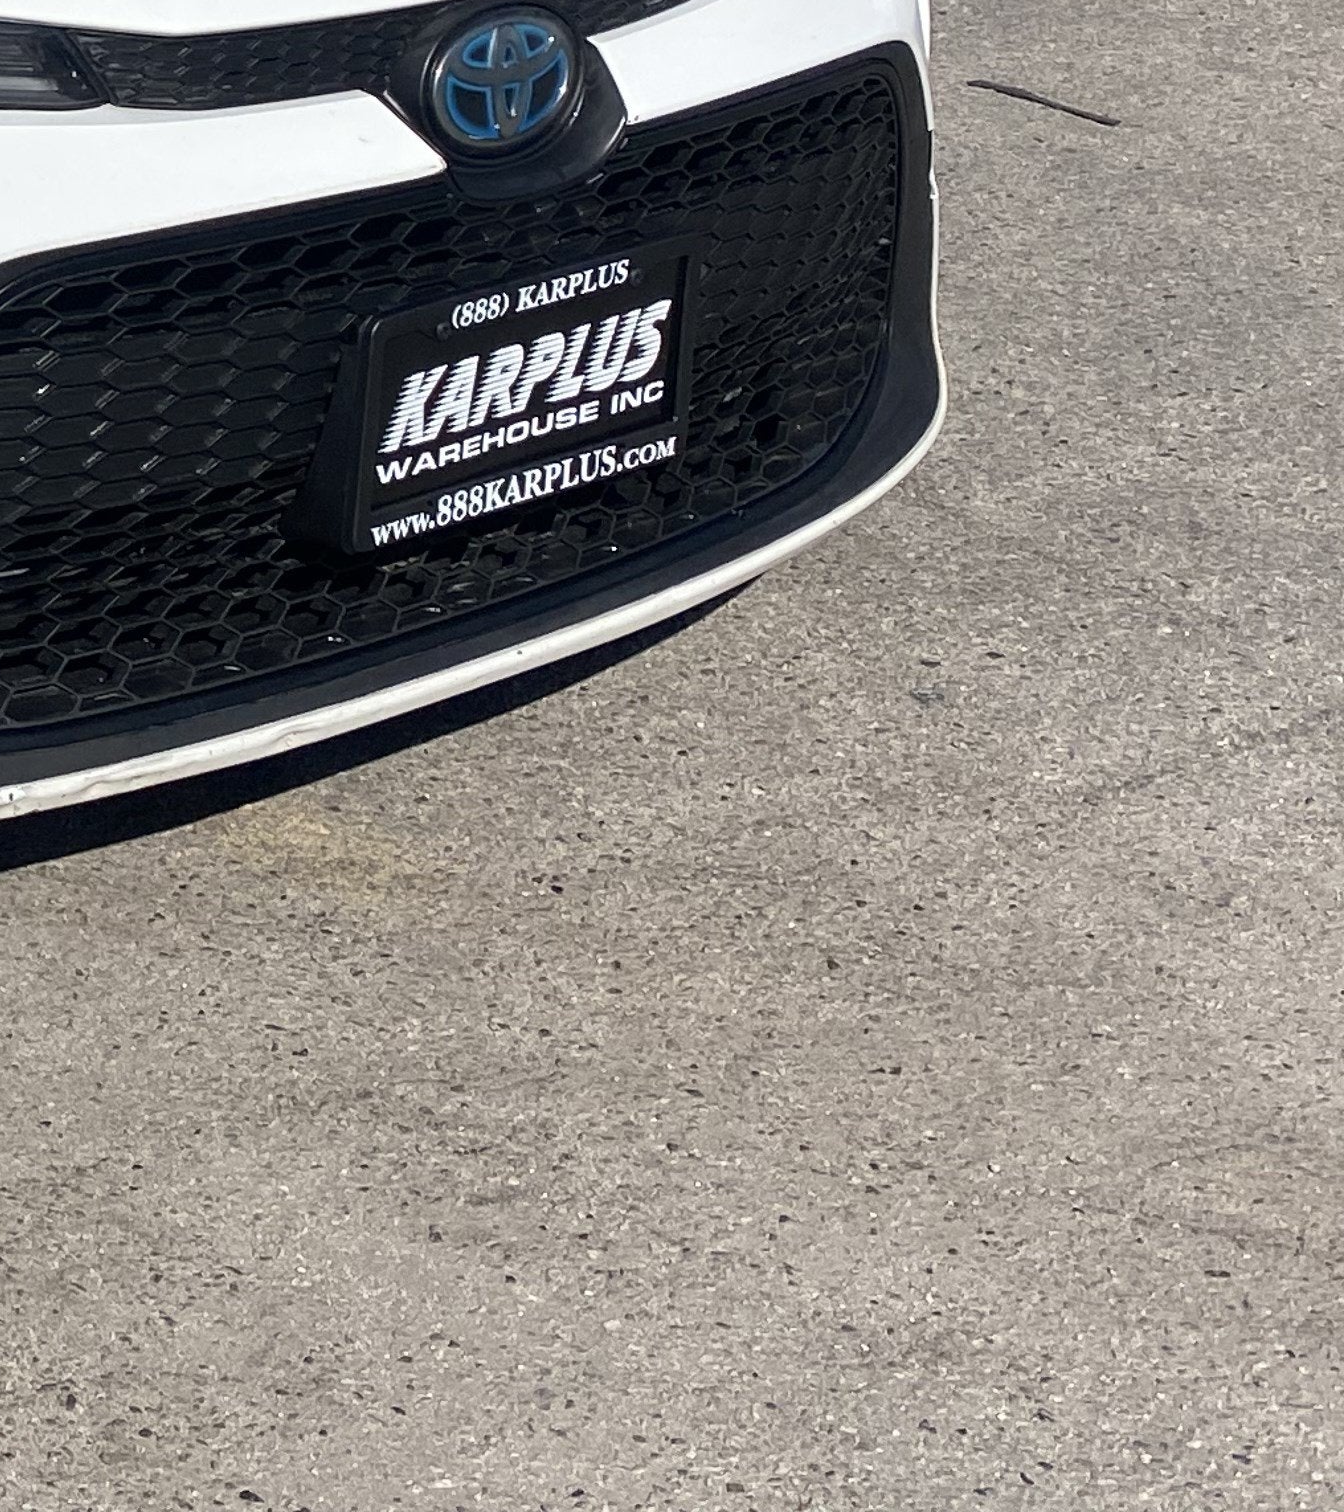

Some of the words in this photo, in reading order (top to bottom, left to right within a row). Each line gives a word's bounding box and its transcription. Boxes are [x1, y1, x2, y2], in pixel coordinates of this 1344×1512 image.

[450, 292, 511, 330] (888)
[515, 259, 630, 312] KARPLUS
[377, 299, 673, 455] KARPLUS
[374, 401, 600, 484] WAREHOUSE
[610, 380, 665, 416] INC
